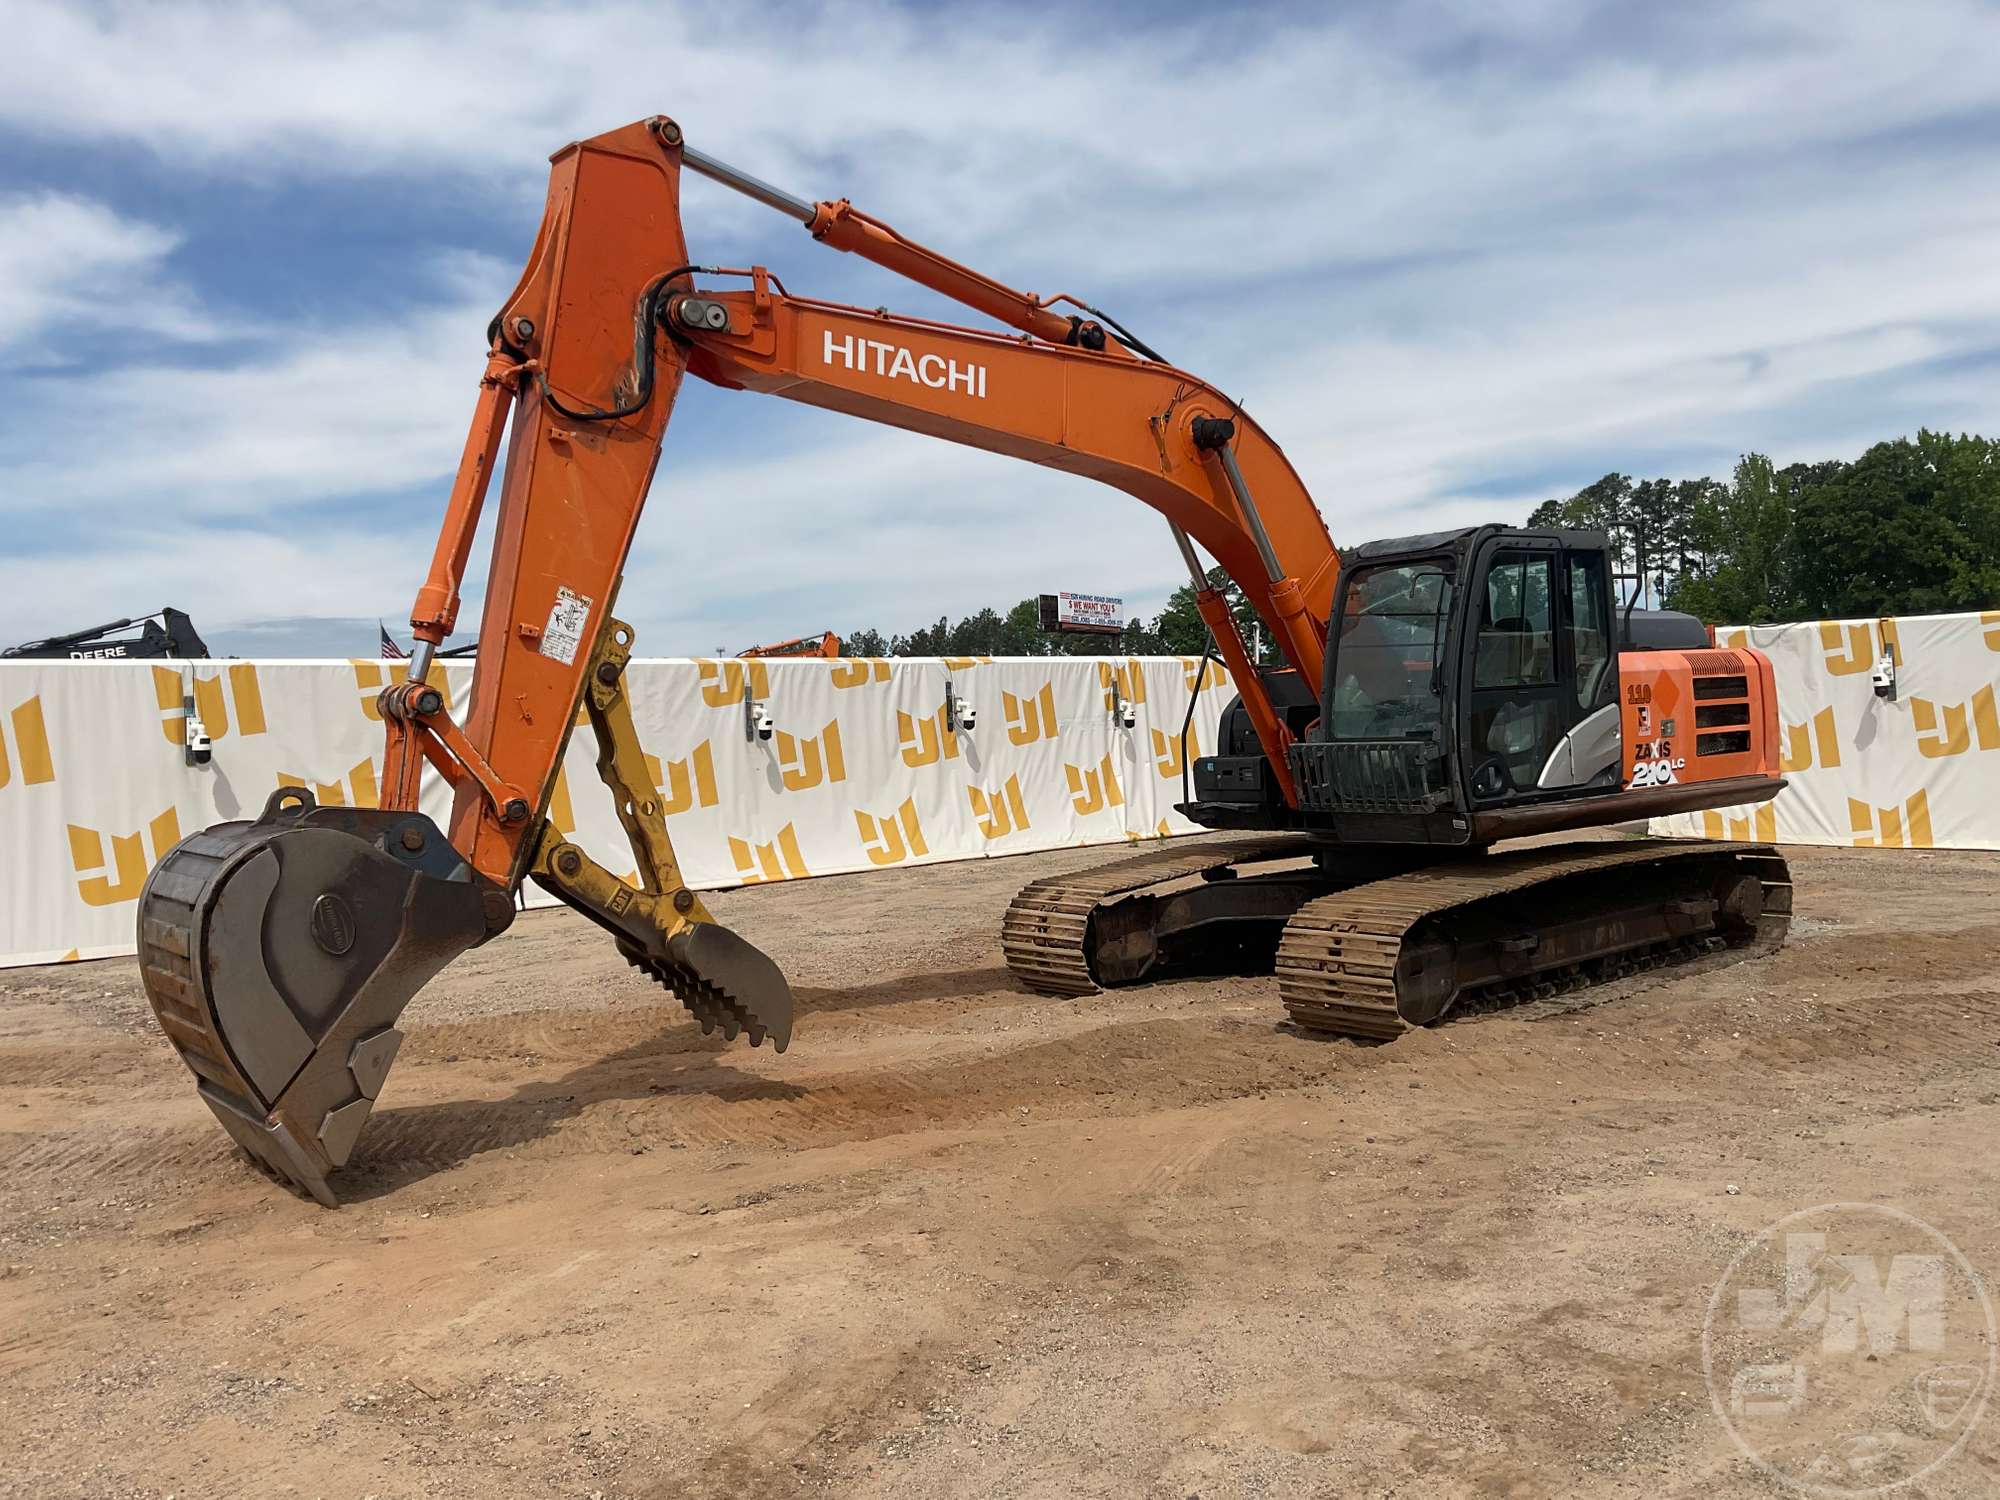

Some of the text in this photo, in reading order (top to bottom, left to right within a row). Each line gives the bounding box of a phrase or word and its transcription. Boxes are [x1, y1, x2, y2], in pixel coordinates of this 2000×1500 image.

[823, 329, 987, 399] HITACHI
[1073, 601, 1082, 609] WE
[1083, 601, 1099, 610] WANT
[1099, 603, 1111, 612] YOU
[70, 646, 127, 659] DEERE
[1627, 684, 1652, 702] 110
[1635, 738, 1671, 760] ZAXIS
[611, 888, 630, 912] CAT
